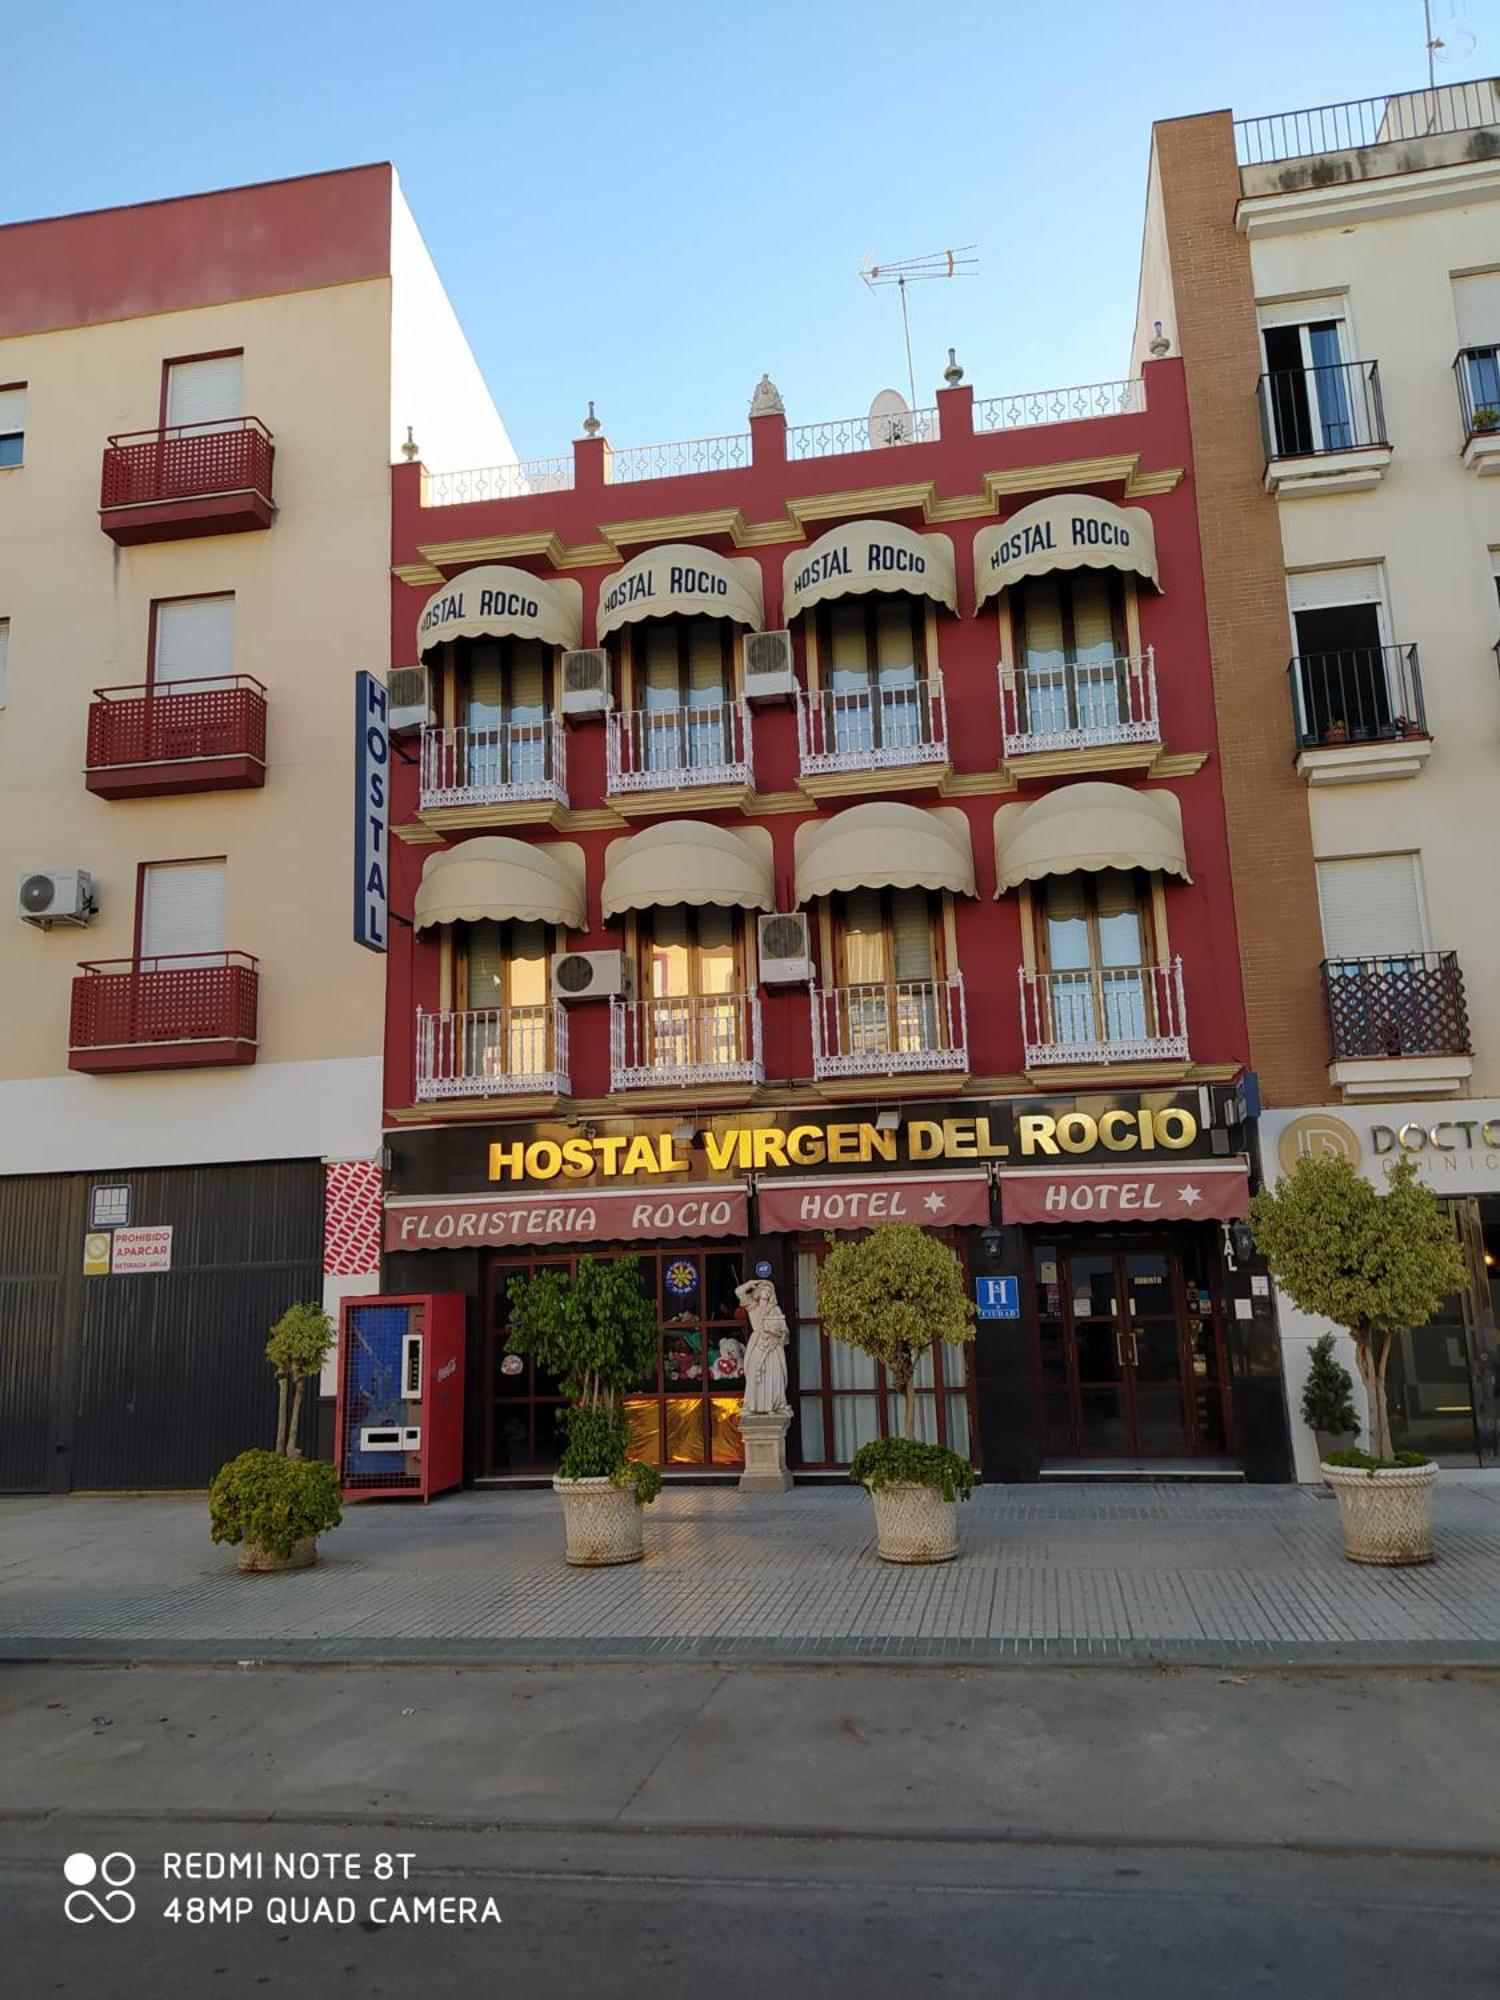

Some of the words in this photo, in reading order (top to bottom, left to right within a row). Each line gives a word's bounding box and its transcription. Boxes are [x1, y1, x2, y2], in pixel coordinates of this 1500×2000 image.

[991, 520, 1057, 570] HOSTAL
[1071, 518, 1131, 547] ROCIO
[794, 546, 853, 595] HOSTAL
[867, 543, 926, 574] ROCIO
[480, 589, 539, 618] ROCIO
[604, 570, 656, 614] HOSTAL
[670, 566, 728, 596] ROCIO
[367, 679, 388, 943] HOSTAL
[488, 1133, 691, 1182] HOSTAL
[704, 1122, 898, 1171] VIRGEN
[908, 1116, 1009, 1161] DEL
[1018, 1108, 1198, 1156] ROCIO
[799, 1191, 908, 1220] HOTEL
[1044, 1183, 1163, 1212] HOTEL
[115, 1232, 170, 1242] PROHIBIDO
[400, 1206, 597, 1240] FLORISTERIA
[632, 1200, 732, 1228] ROCIO
[117, 1245, 168, 1256] APARCAR
